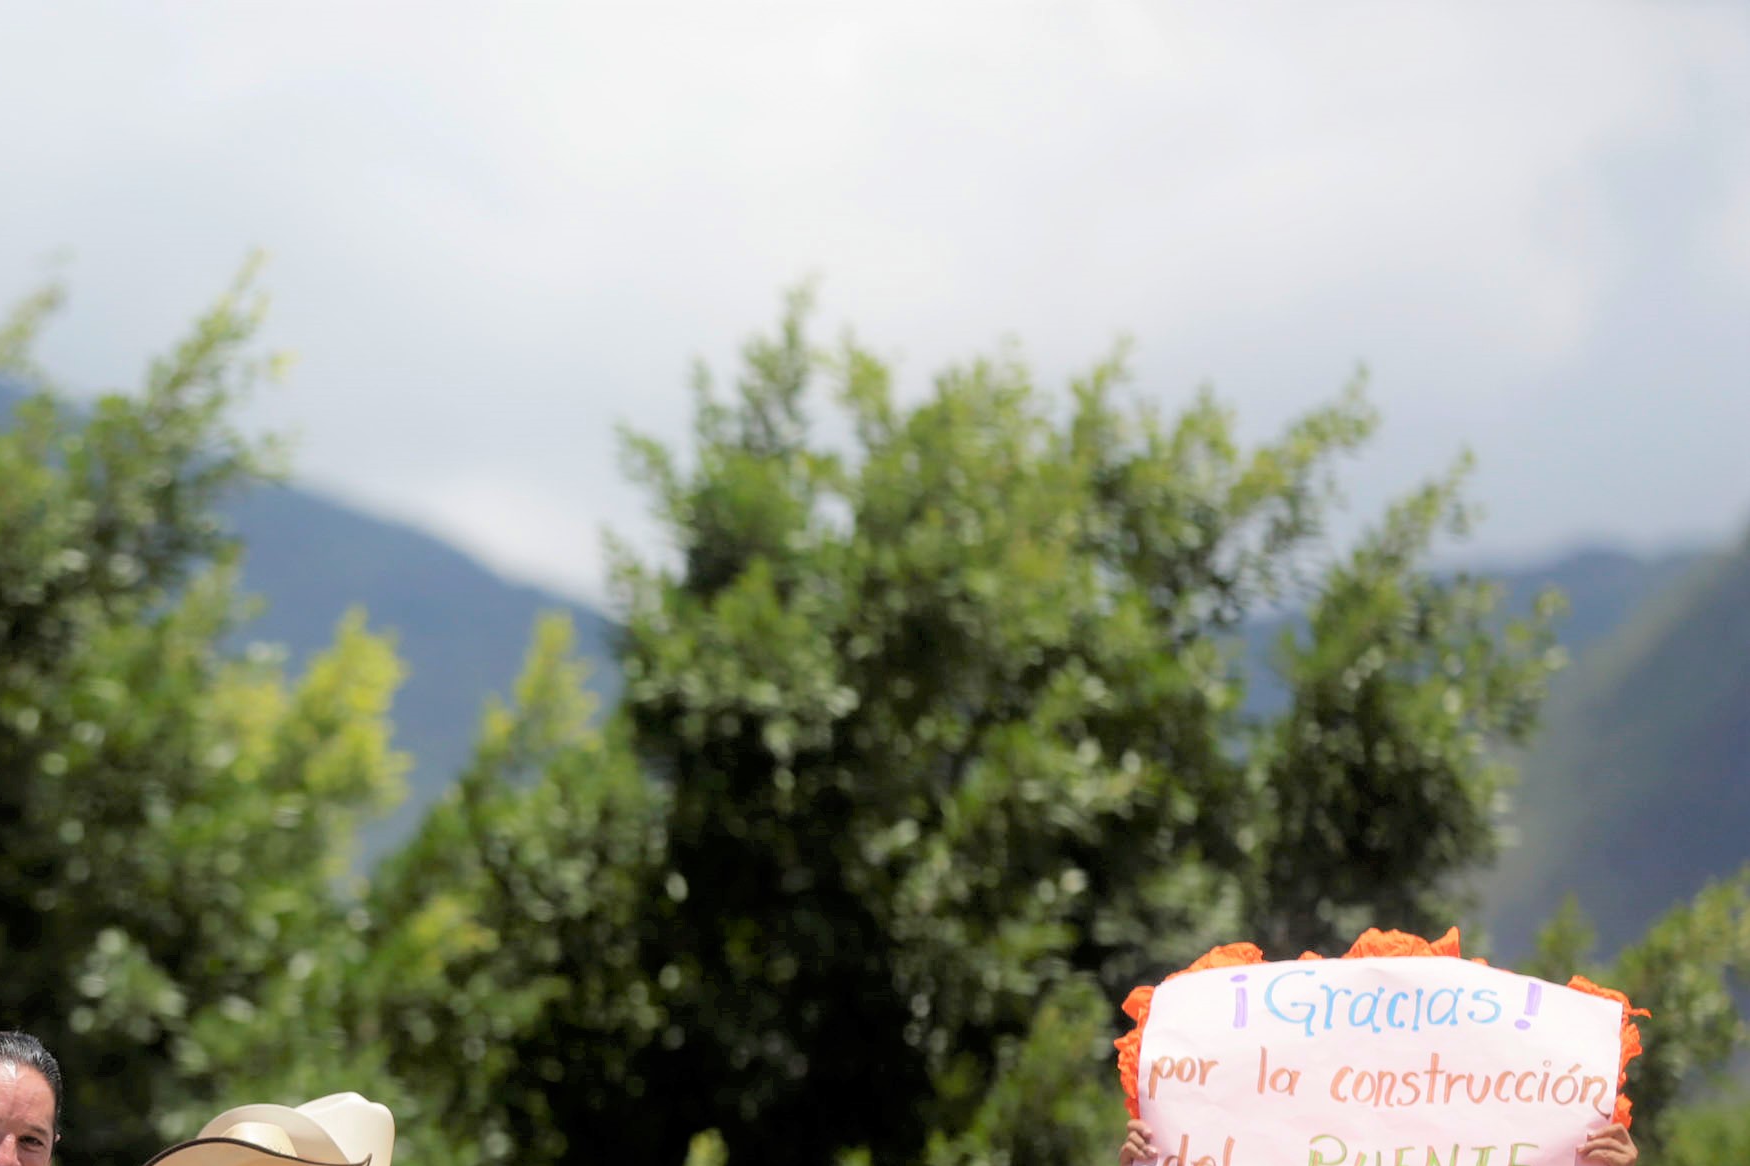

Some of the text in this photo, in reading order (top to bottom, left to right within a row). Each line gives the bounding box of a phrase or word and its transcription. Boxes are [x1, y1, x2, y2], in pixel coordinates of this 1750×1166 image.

[1148, 1046, 1612, 1117] por la construcción
